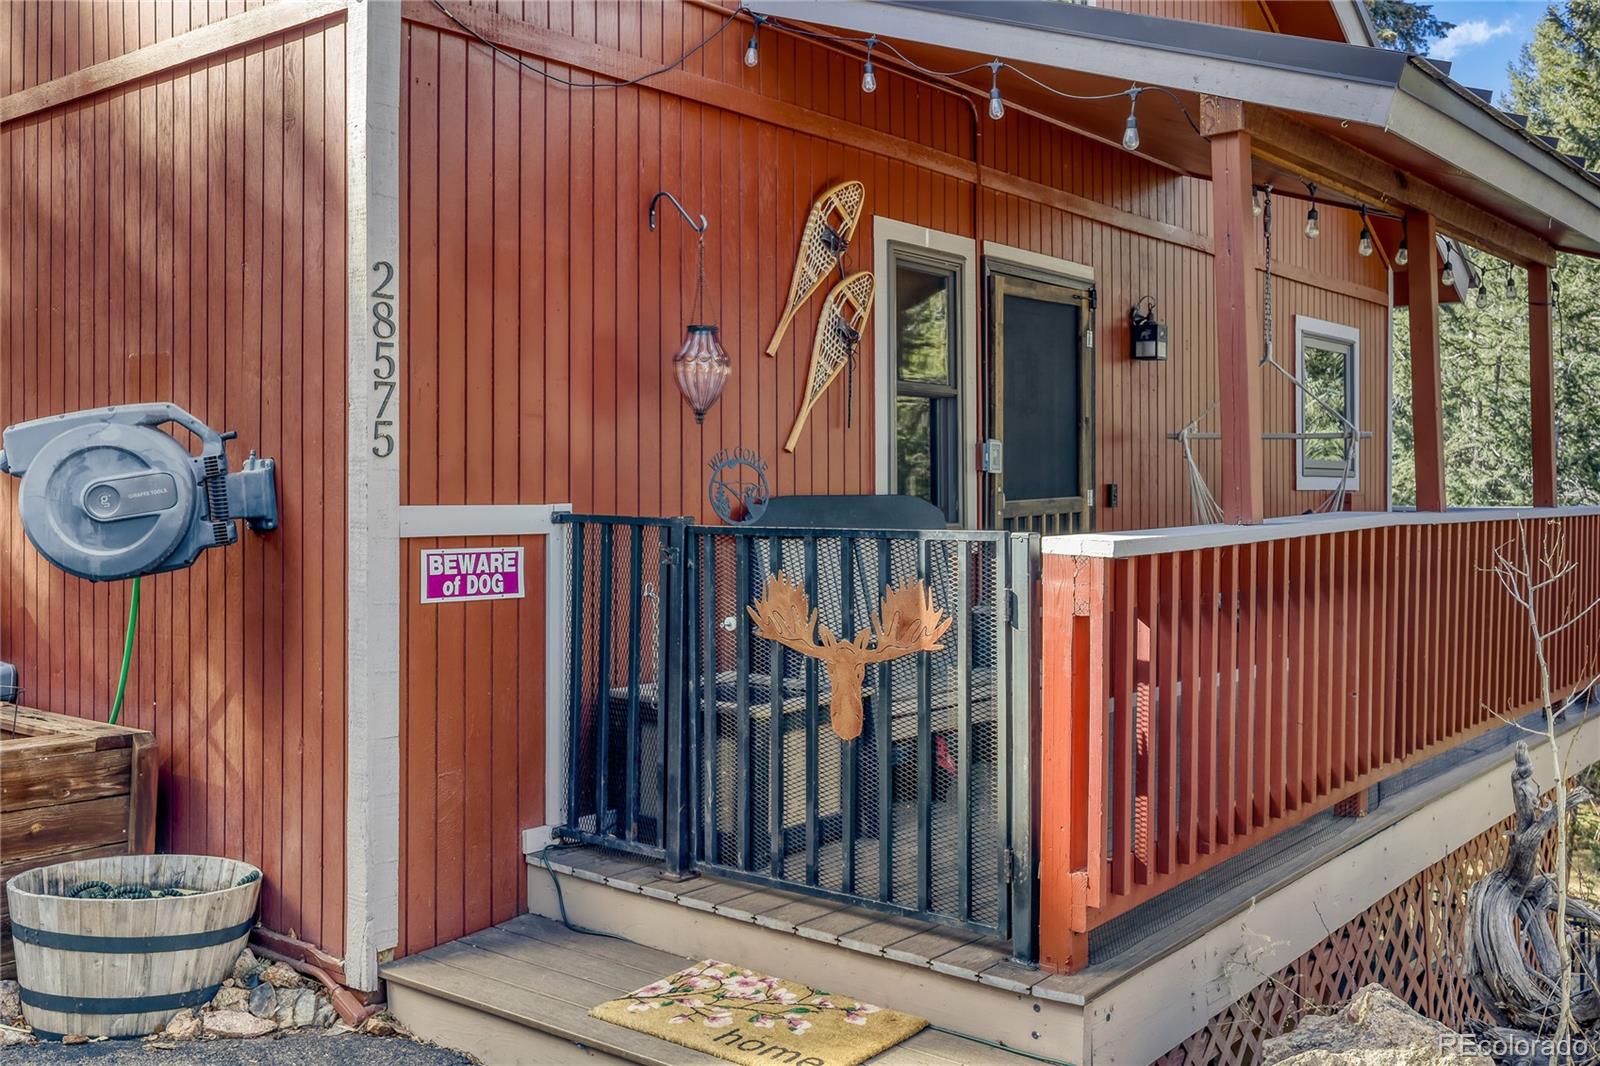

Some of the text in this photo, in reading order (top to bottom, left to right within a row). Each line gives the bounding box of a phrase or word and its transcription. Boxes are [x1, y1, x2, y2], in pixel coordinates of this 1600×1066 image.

[371, 261, 397, 458] 28575
[706, 446, 769, 473] WELCOME
[150, 487, 169, 497] TOOLS
[429, 552, 517, 576] BEWARE
[442, 573, 505, 596] of DOG
